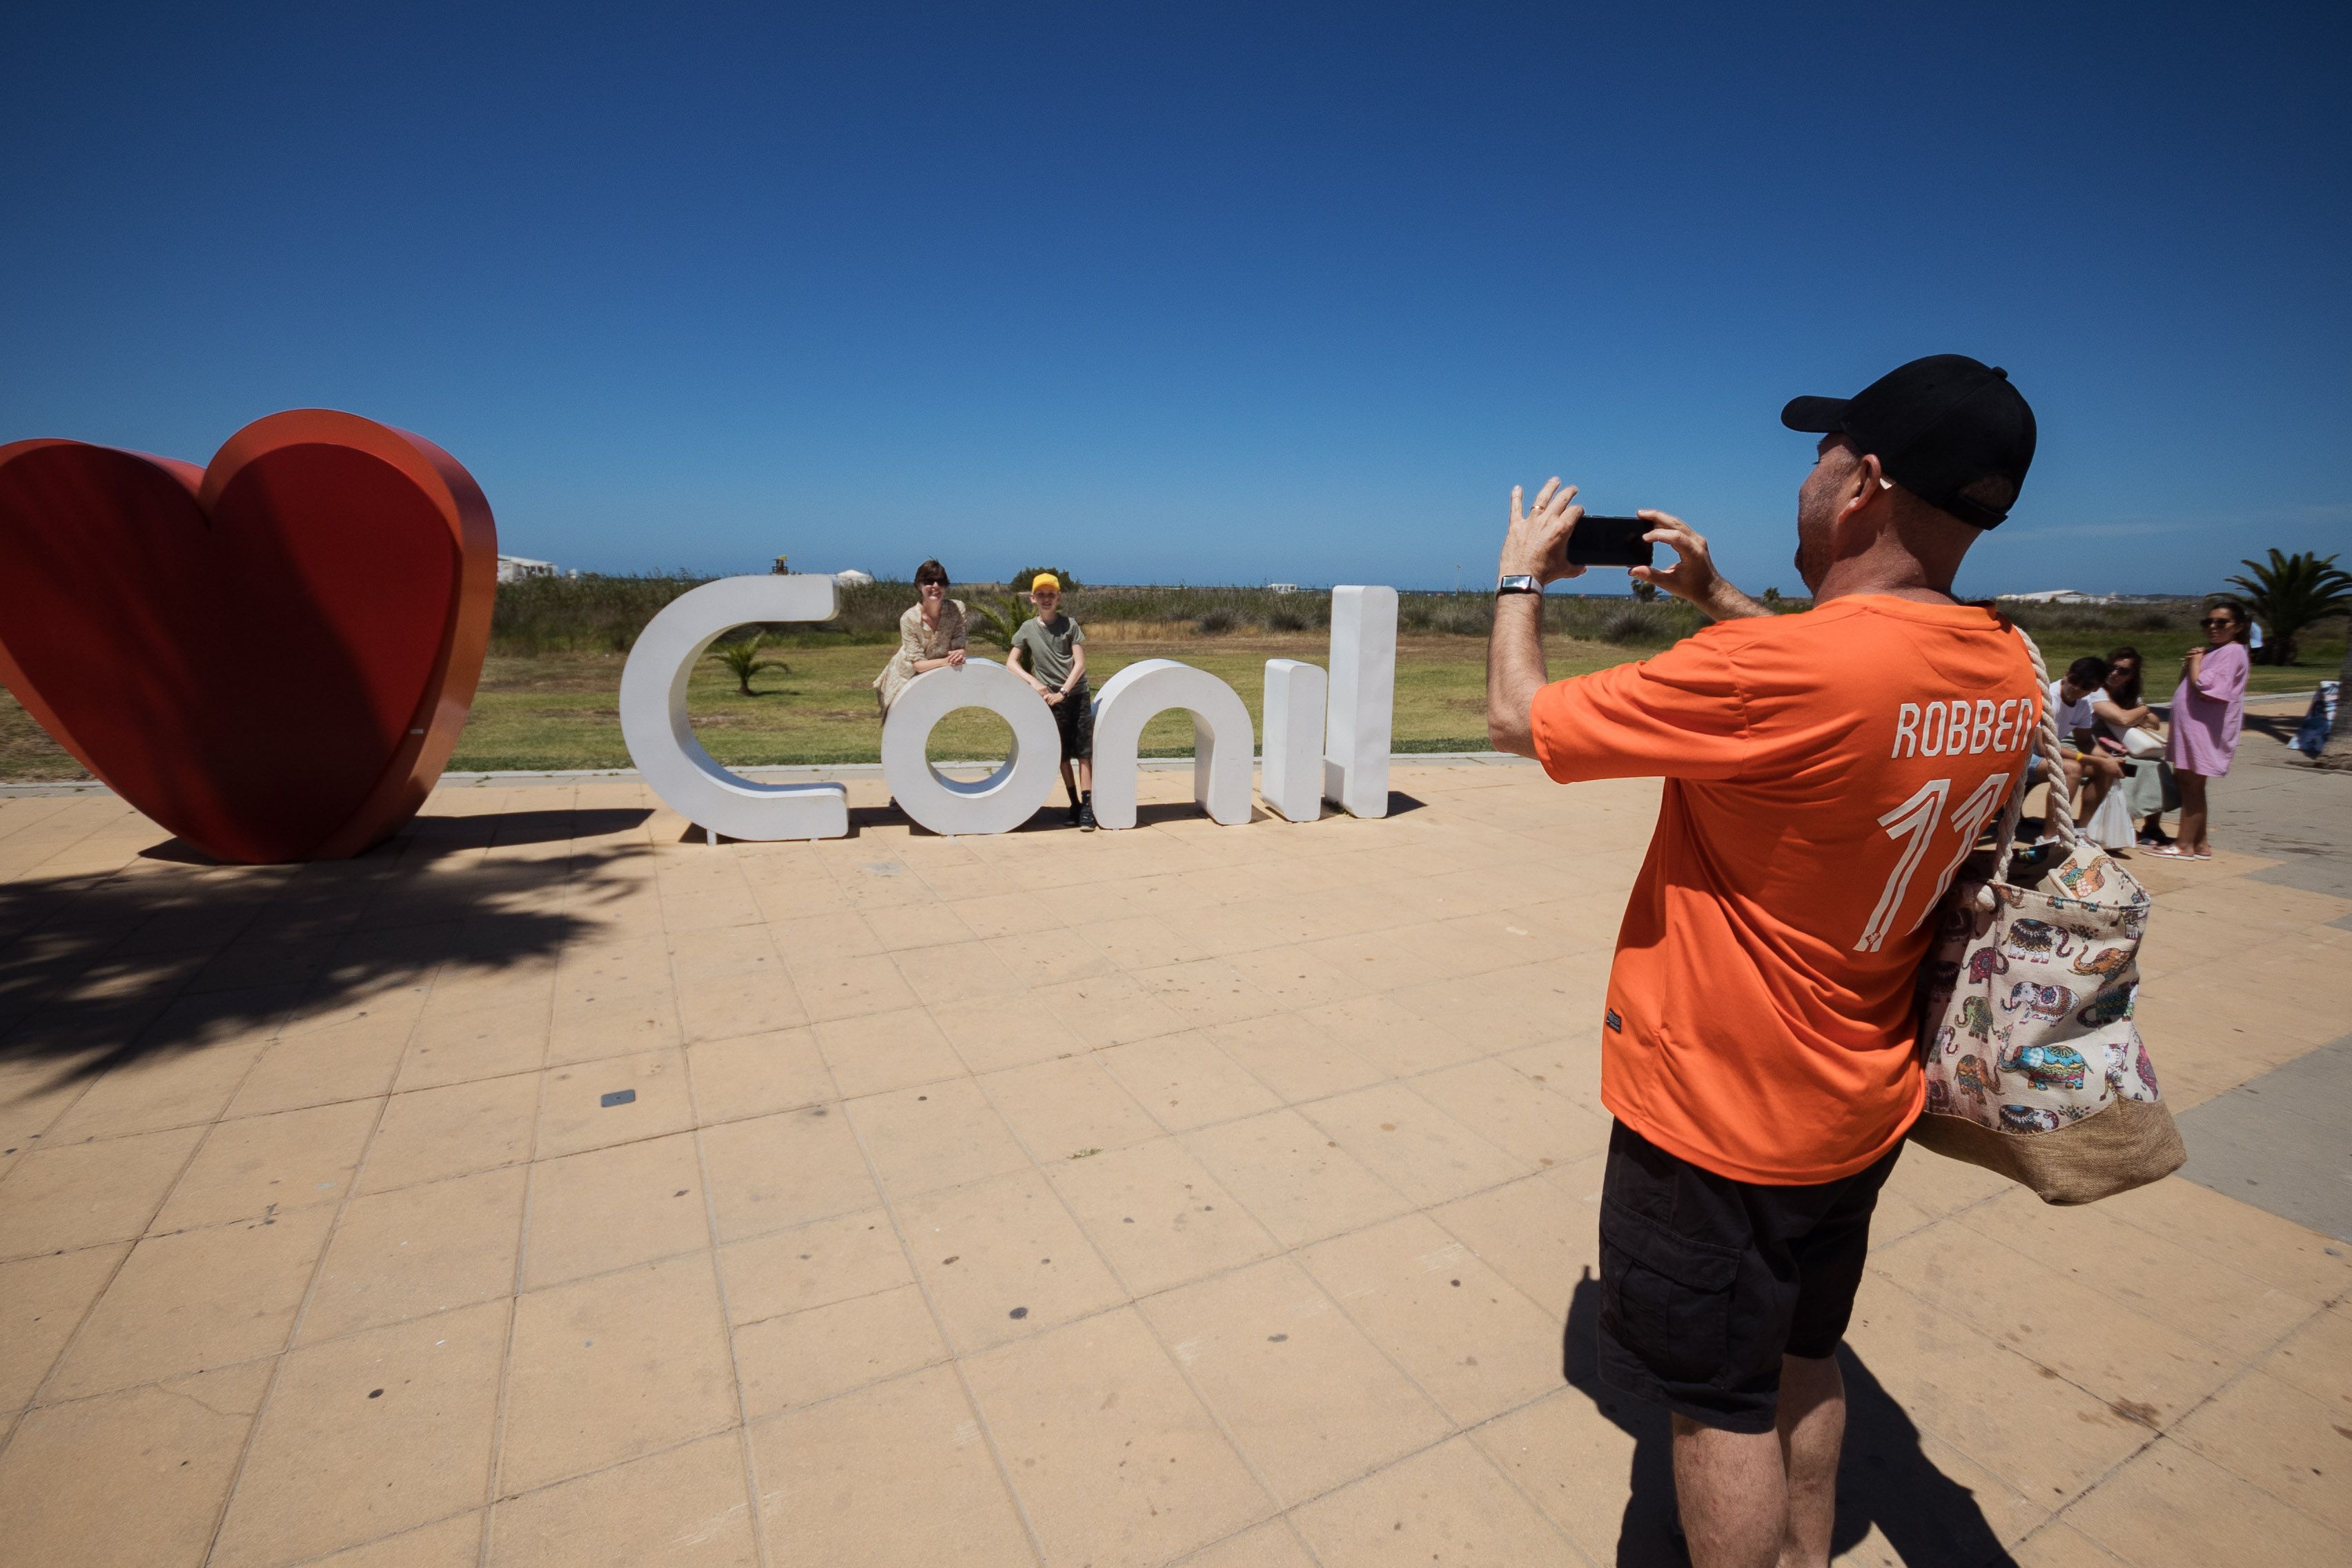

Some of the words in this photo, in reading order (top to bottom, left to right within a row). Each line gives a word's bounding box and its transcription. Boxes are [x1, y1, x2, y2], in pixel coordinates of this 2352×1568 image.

[619, 574, 1399, 842] Conil
[1891, 698, 2033, 758] ROBBEN
[1852, 772, 2010, 952] 11
